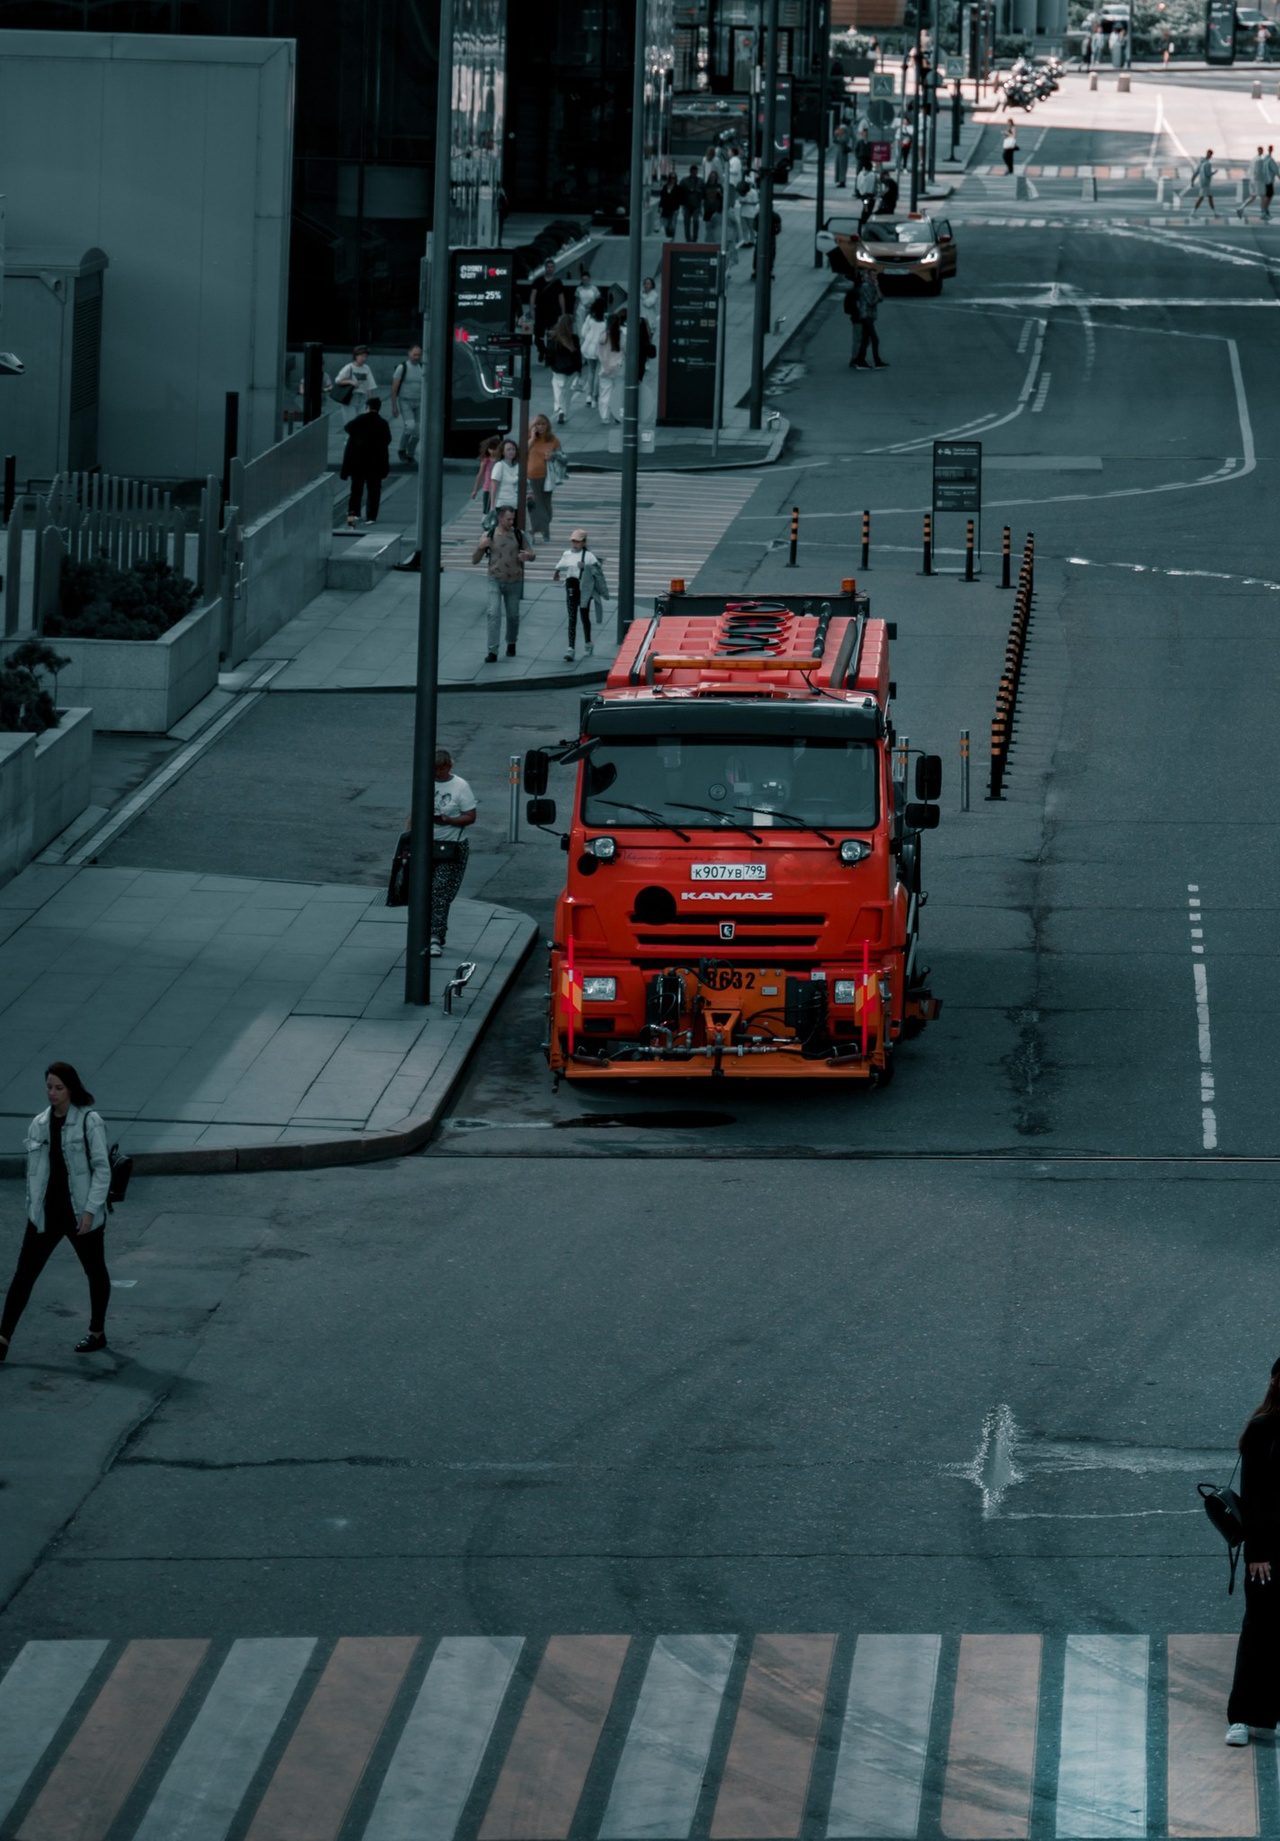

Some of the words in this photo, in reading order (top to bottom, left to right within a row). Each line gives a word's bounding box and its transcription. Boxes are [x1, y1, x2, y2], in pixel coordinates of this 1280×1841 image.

[485, 290, 502, 300] 25%
[745, 865, 763, 875] 799
[681, 892, 773, 900] KAMAZ
